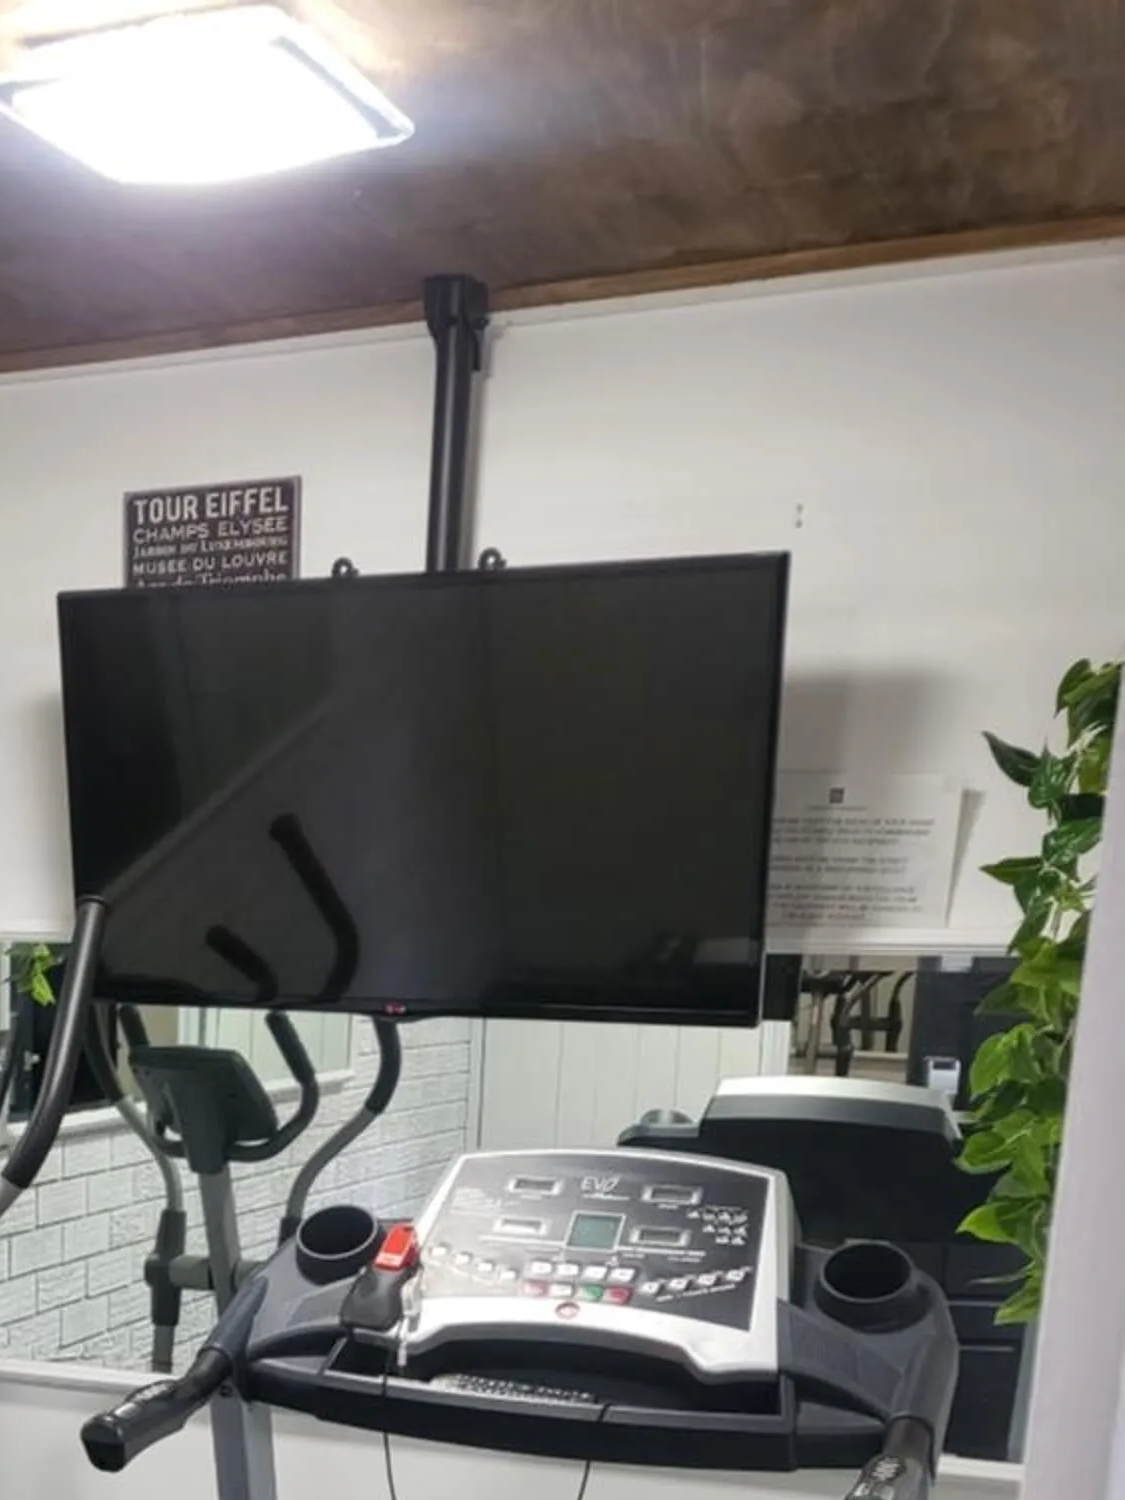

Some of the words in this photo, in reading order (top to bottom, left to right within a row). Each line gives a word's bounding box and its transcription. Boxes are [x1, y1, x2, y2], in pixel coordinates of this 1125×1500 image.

[134, 495, 198, 524] TOUR
[206, 487, 289, 518] EIFFEL
[133, 522, 210, 544] CHAMPS
[218, 517, 288, 537] ELYSEE
[133, 558, 187, 575] MUSEE
[192, 556, 216, 571] DU
[222, 551, 288, 569] LOUVRE
